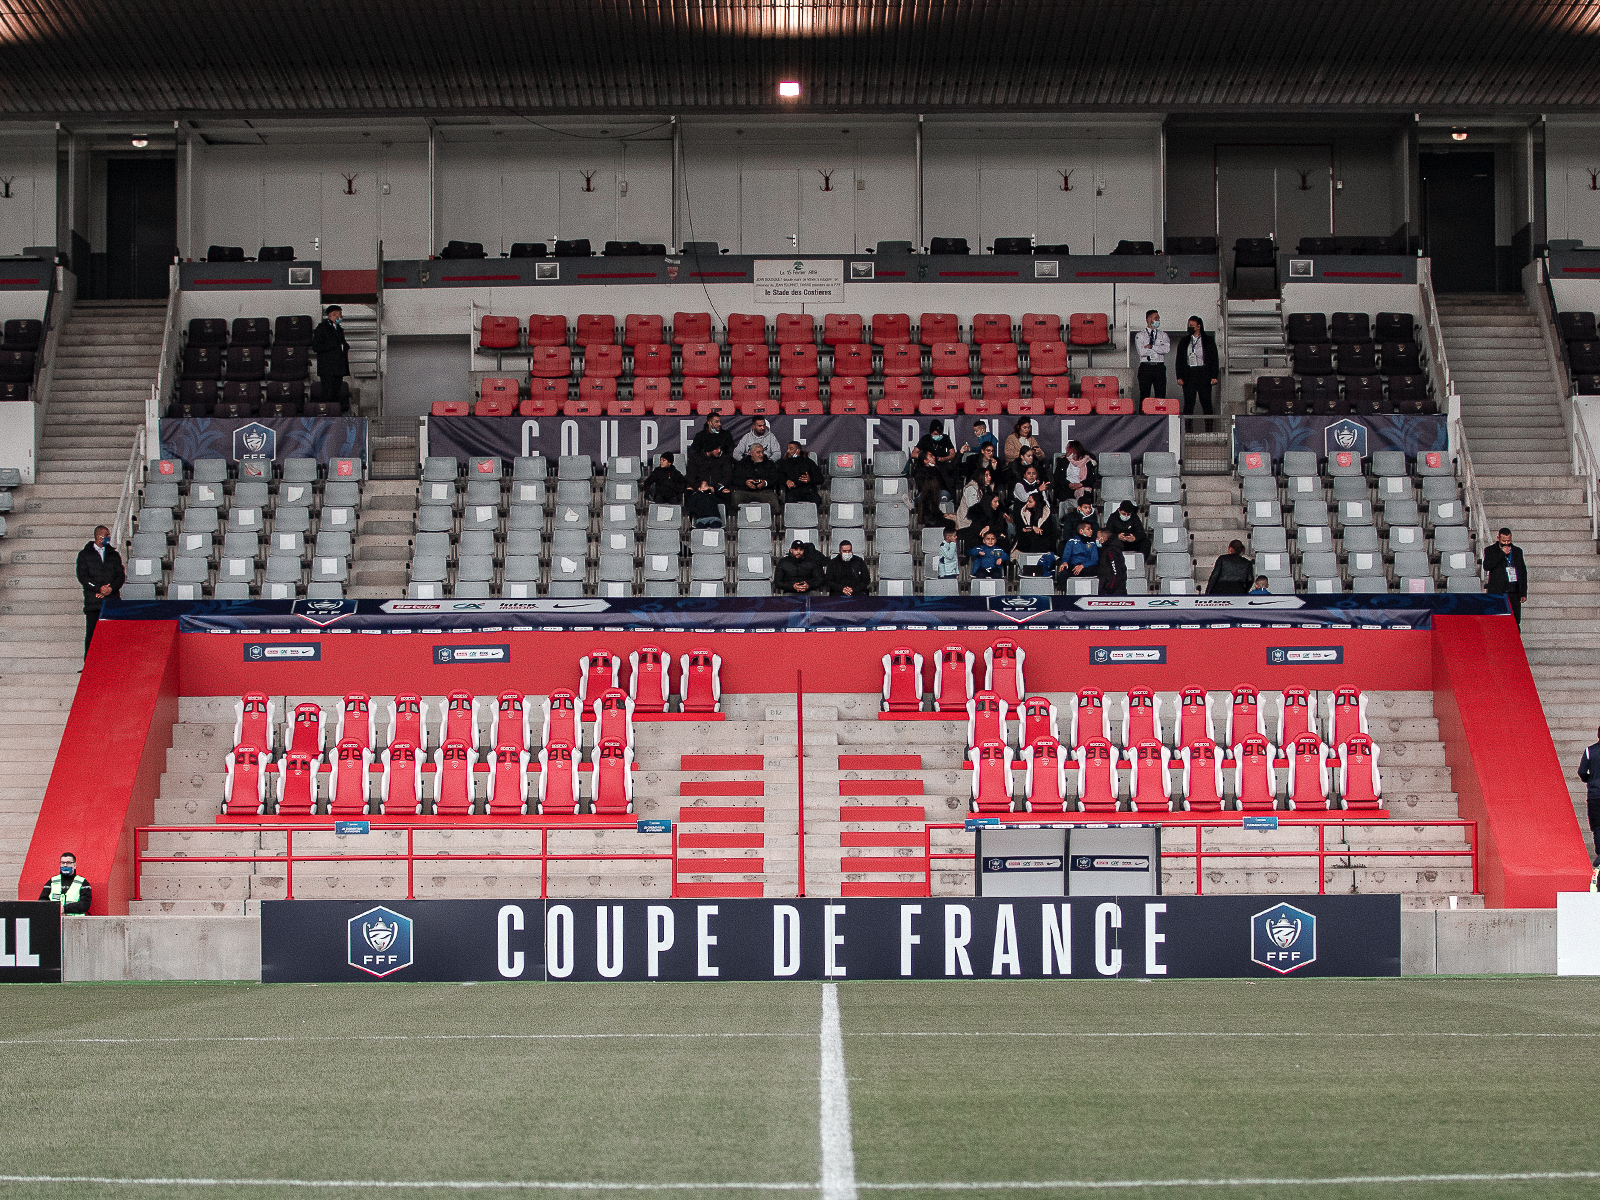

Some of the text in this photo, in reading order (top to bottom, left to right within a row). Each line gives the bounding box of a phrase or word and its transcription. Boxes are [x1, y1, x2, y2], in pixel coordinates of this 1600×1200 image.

[521, 419, 695, 467] COUPE
[867, 418, 1076, 465] FRANE
[498, 902, 1168, 978] COUPE DE FRANCE
[363, 955, 398, 965] FFF
[1266, 951, 1301, 961] FFF
